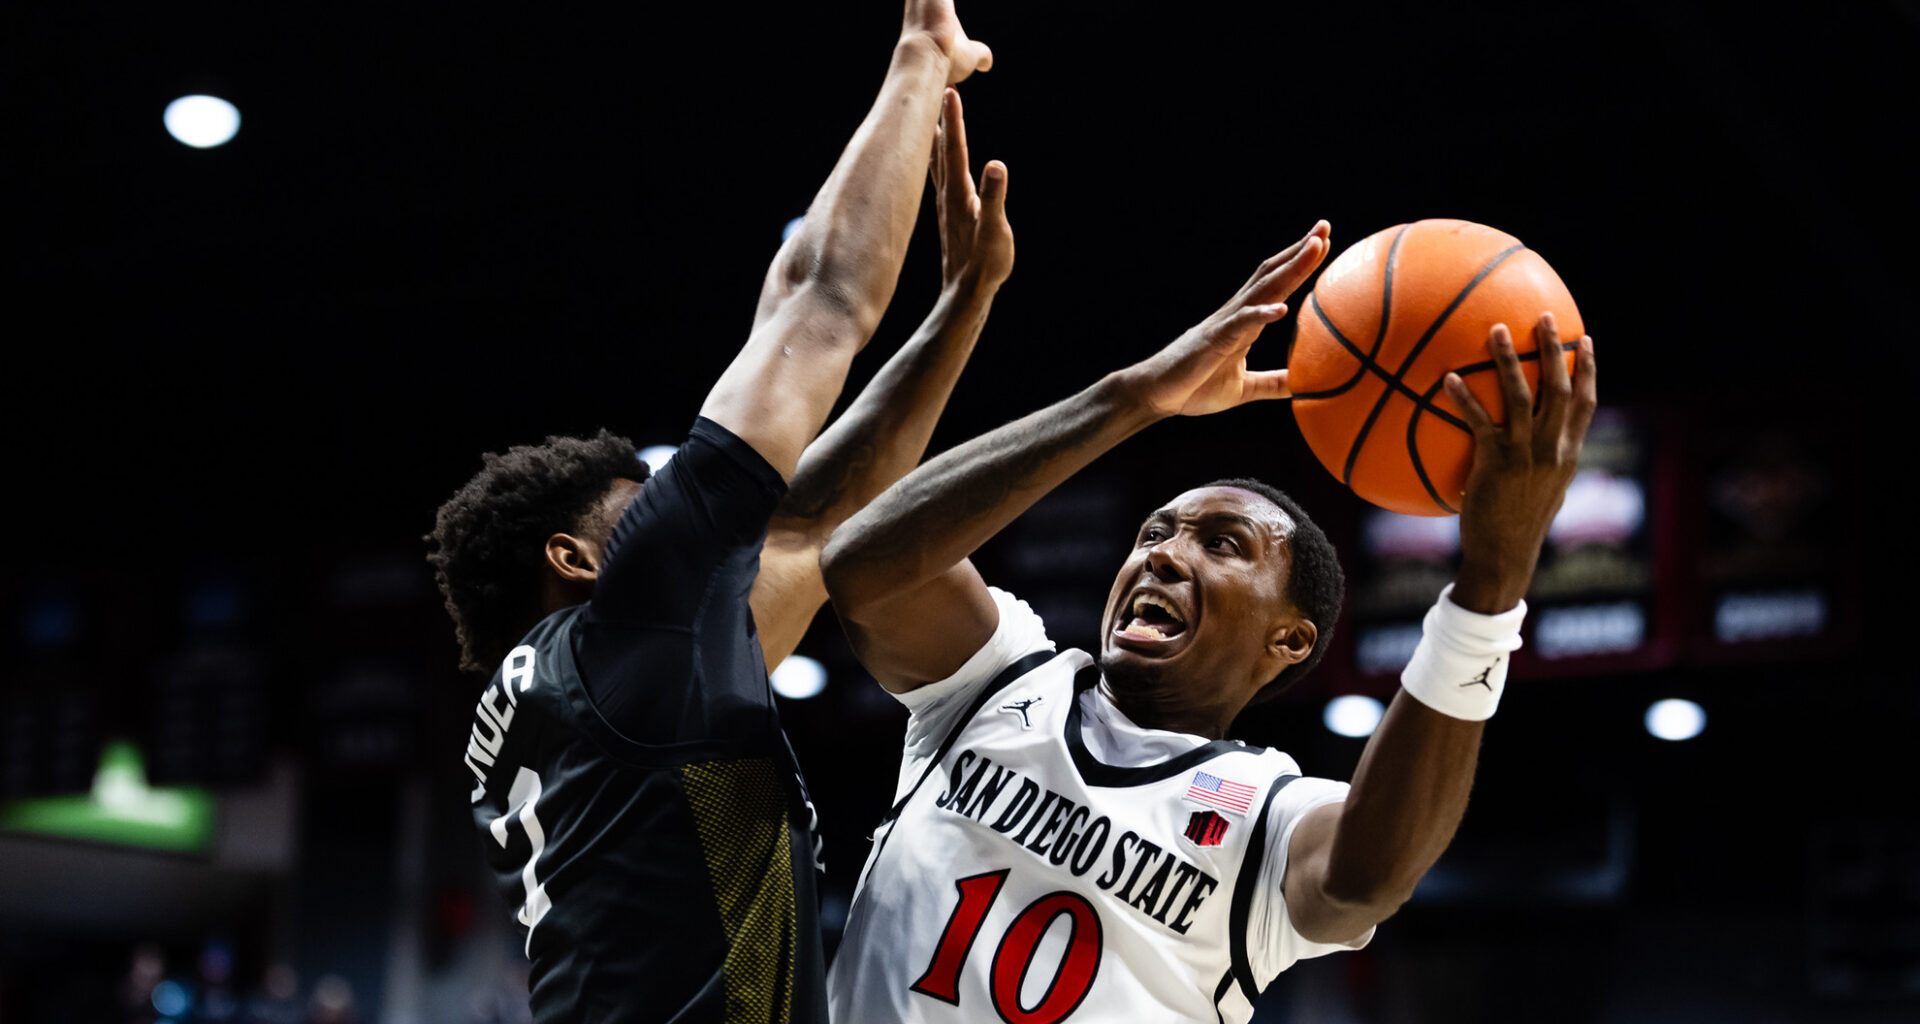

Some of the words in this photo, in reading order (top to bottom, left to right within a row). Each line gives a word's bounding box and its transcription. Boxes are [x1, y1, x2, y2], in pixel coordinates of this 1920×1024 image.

[936, 749, 1017, 823] SAN
[990, 777, 1111, 877] DIEGO
[1096, 830, 1219, 935] STATE
[909, 868, 1104, 1024] 10
